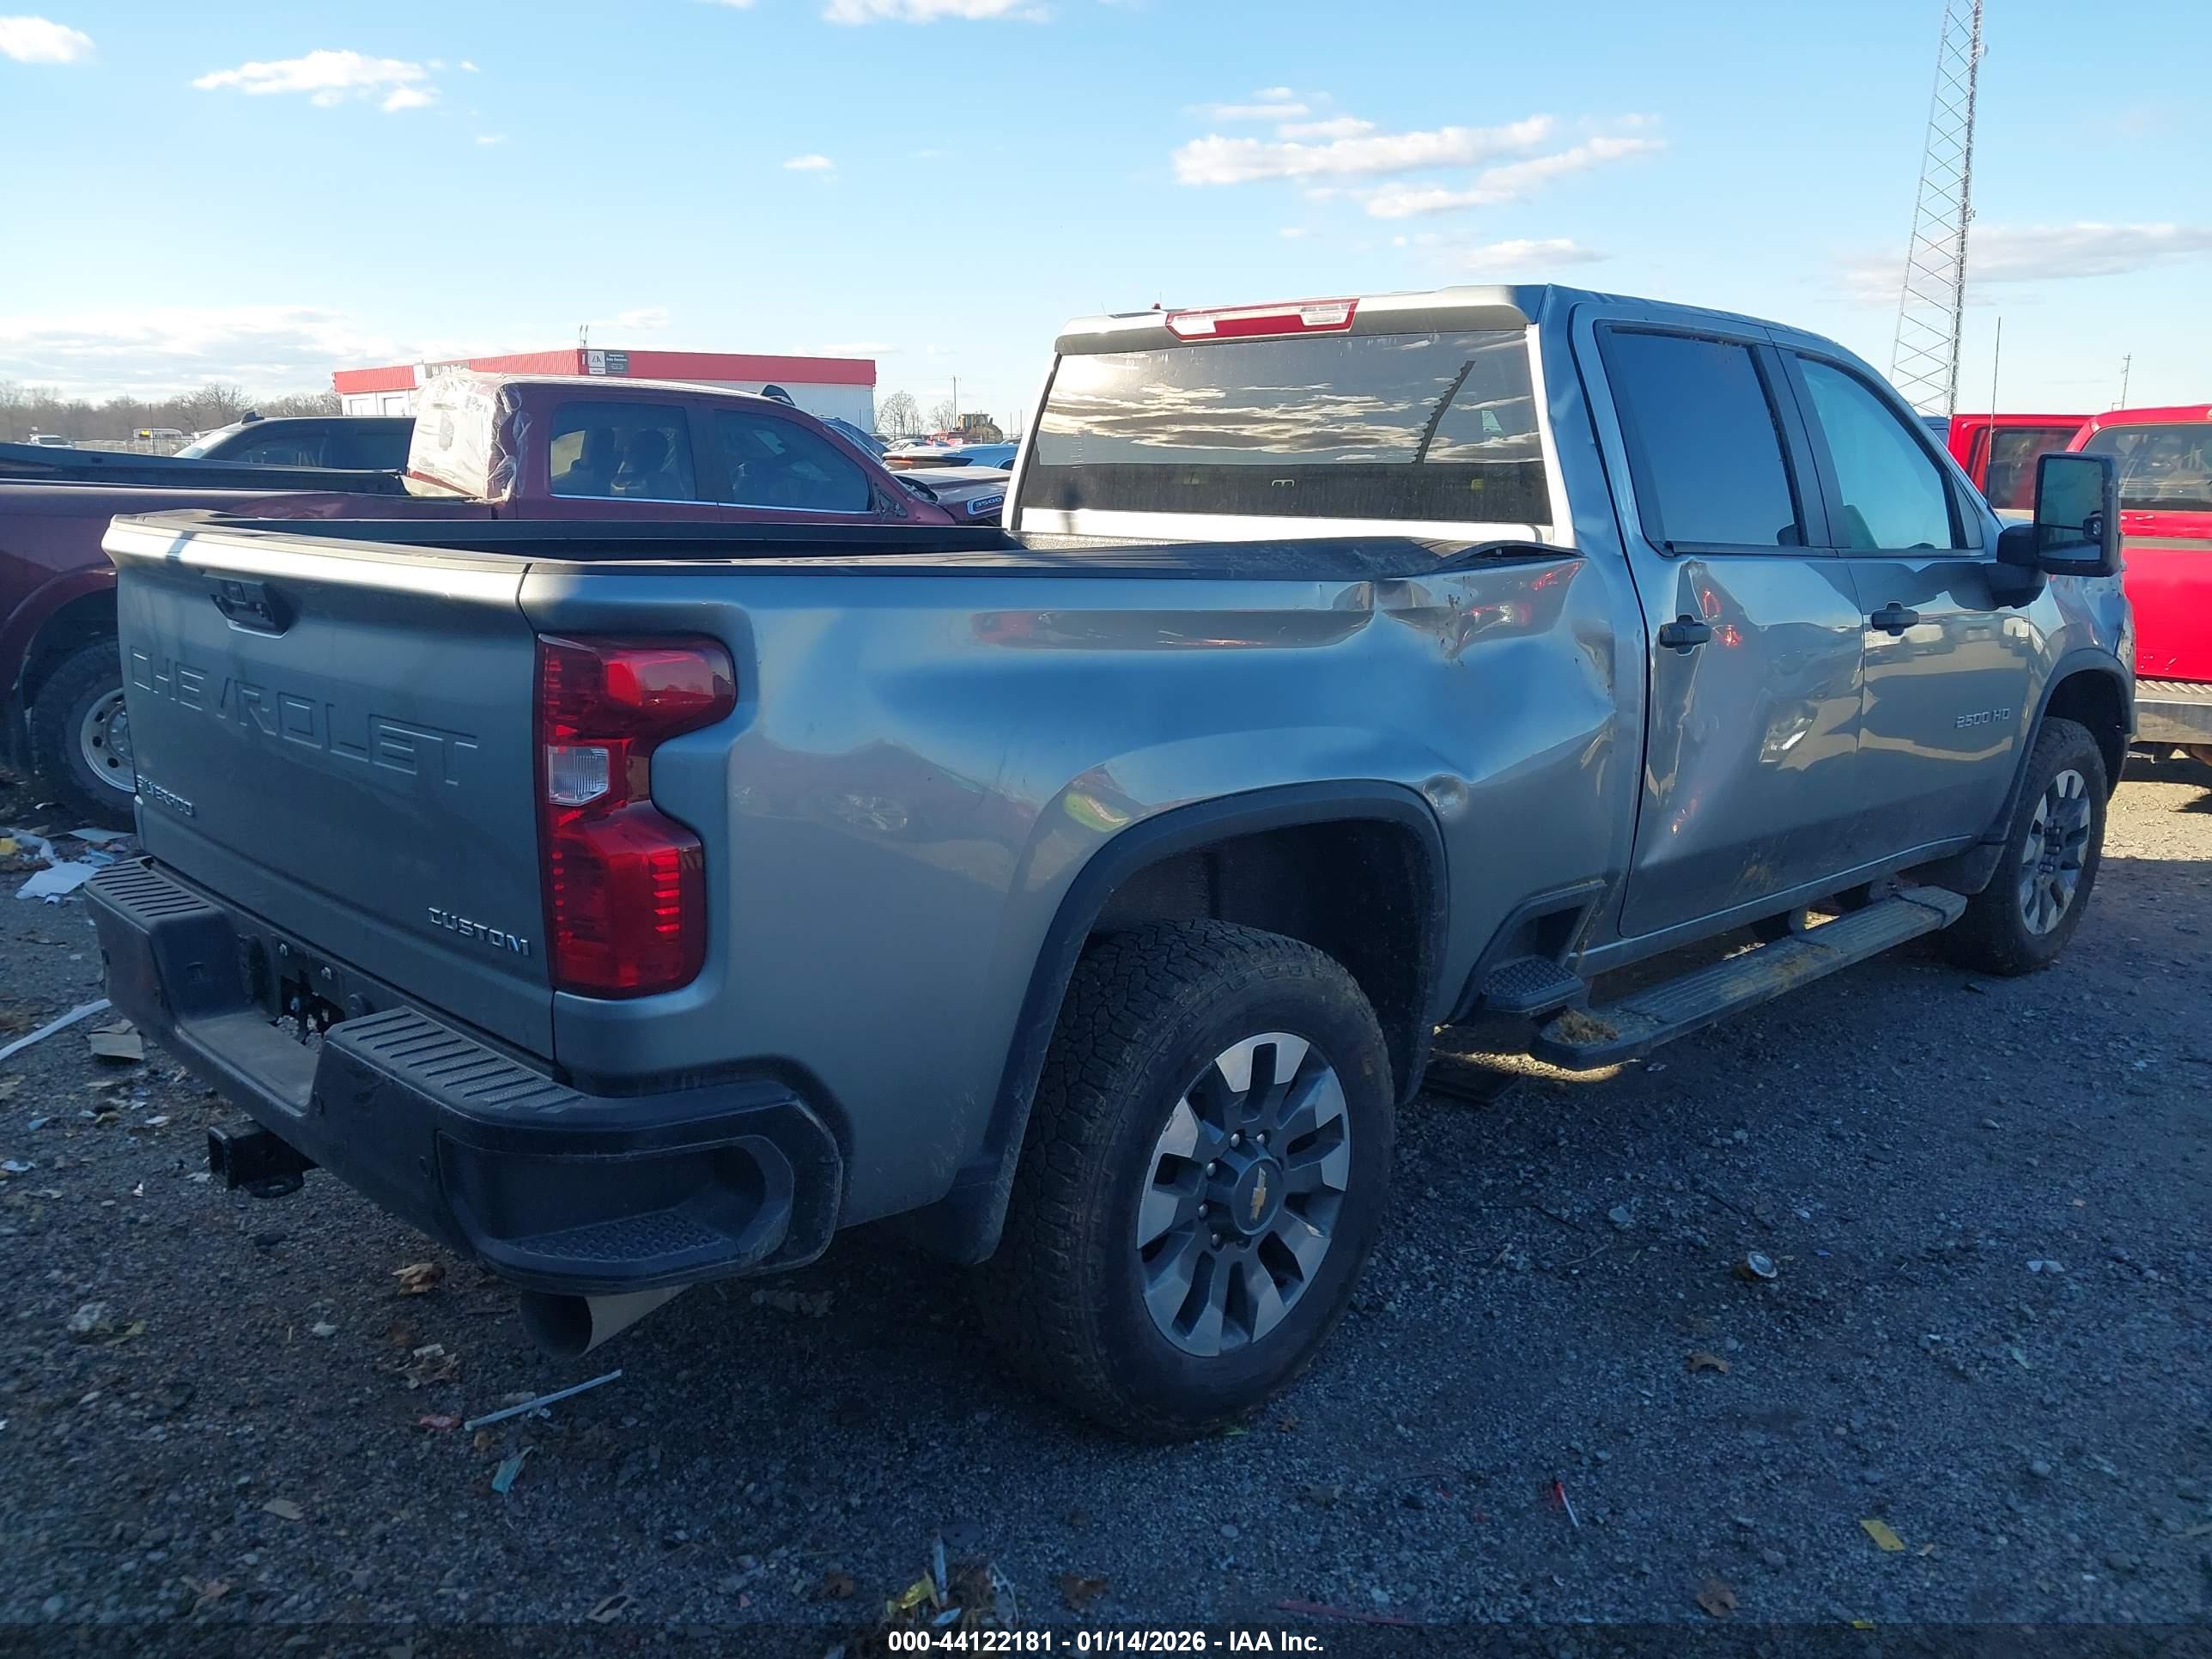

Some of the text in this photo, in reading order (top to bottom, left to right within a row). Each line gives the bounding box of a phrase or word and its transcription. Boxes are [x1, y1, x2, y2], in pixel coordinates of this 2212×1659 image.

[974, 496, 1003, 507] 3500
[129, 645, 479, 787] CHEVROLET
[1956, 708, 2010, 728] 2500 HD
[428, 907, 530, 957] CUSTOM
